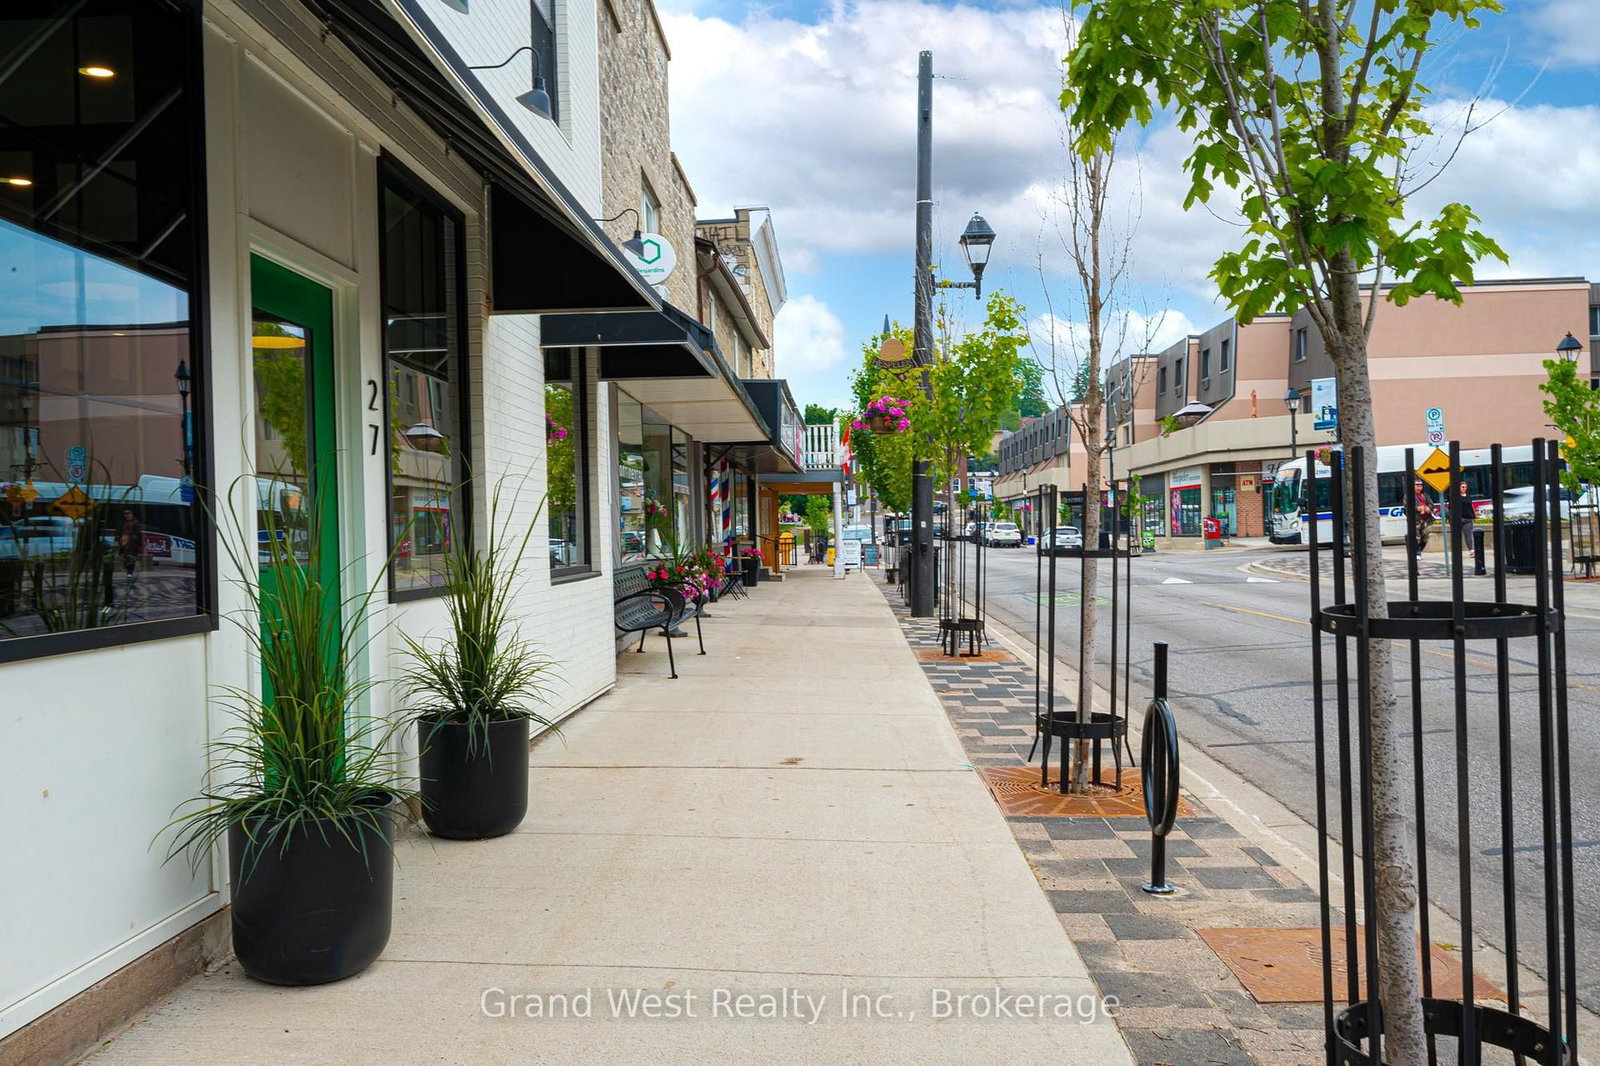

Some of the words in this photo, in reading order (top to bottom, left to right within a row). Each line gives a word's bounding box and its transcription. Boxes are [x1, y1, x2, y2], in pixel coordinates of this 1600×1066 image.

[367, 379, 379, 455] 27
[1242, 479, 1253, 487] ATM
[1390, 507, 1406, 517] GR
